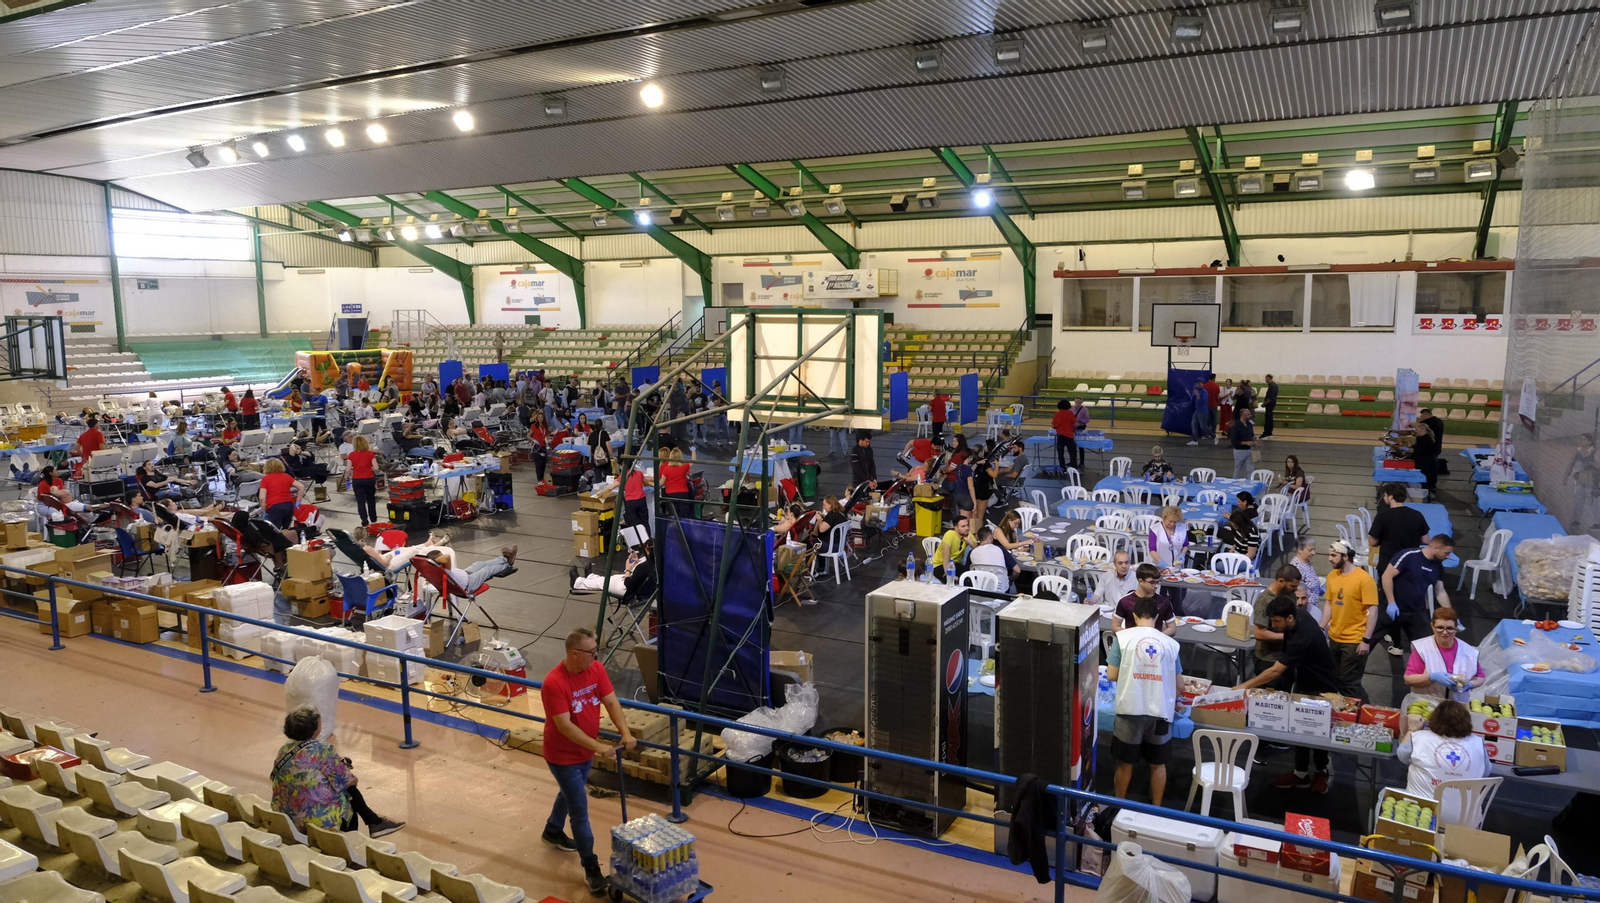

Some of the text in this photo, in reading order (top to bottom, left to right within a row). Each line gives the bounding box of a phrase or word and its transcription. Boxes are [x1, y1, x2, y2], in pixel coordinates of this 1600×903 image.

[935, 268, 977, 280] cajamar
[518, 279, 545, 289] cajamar
[65, 310, 95, 318] cajamar
[1255, 701, 1284, 710] MARITOÑI
[1295, 707, 1325, 716] MARITOÑI
